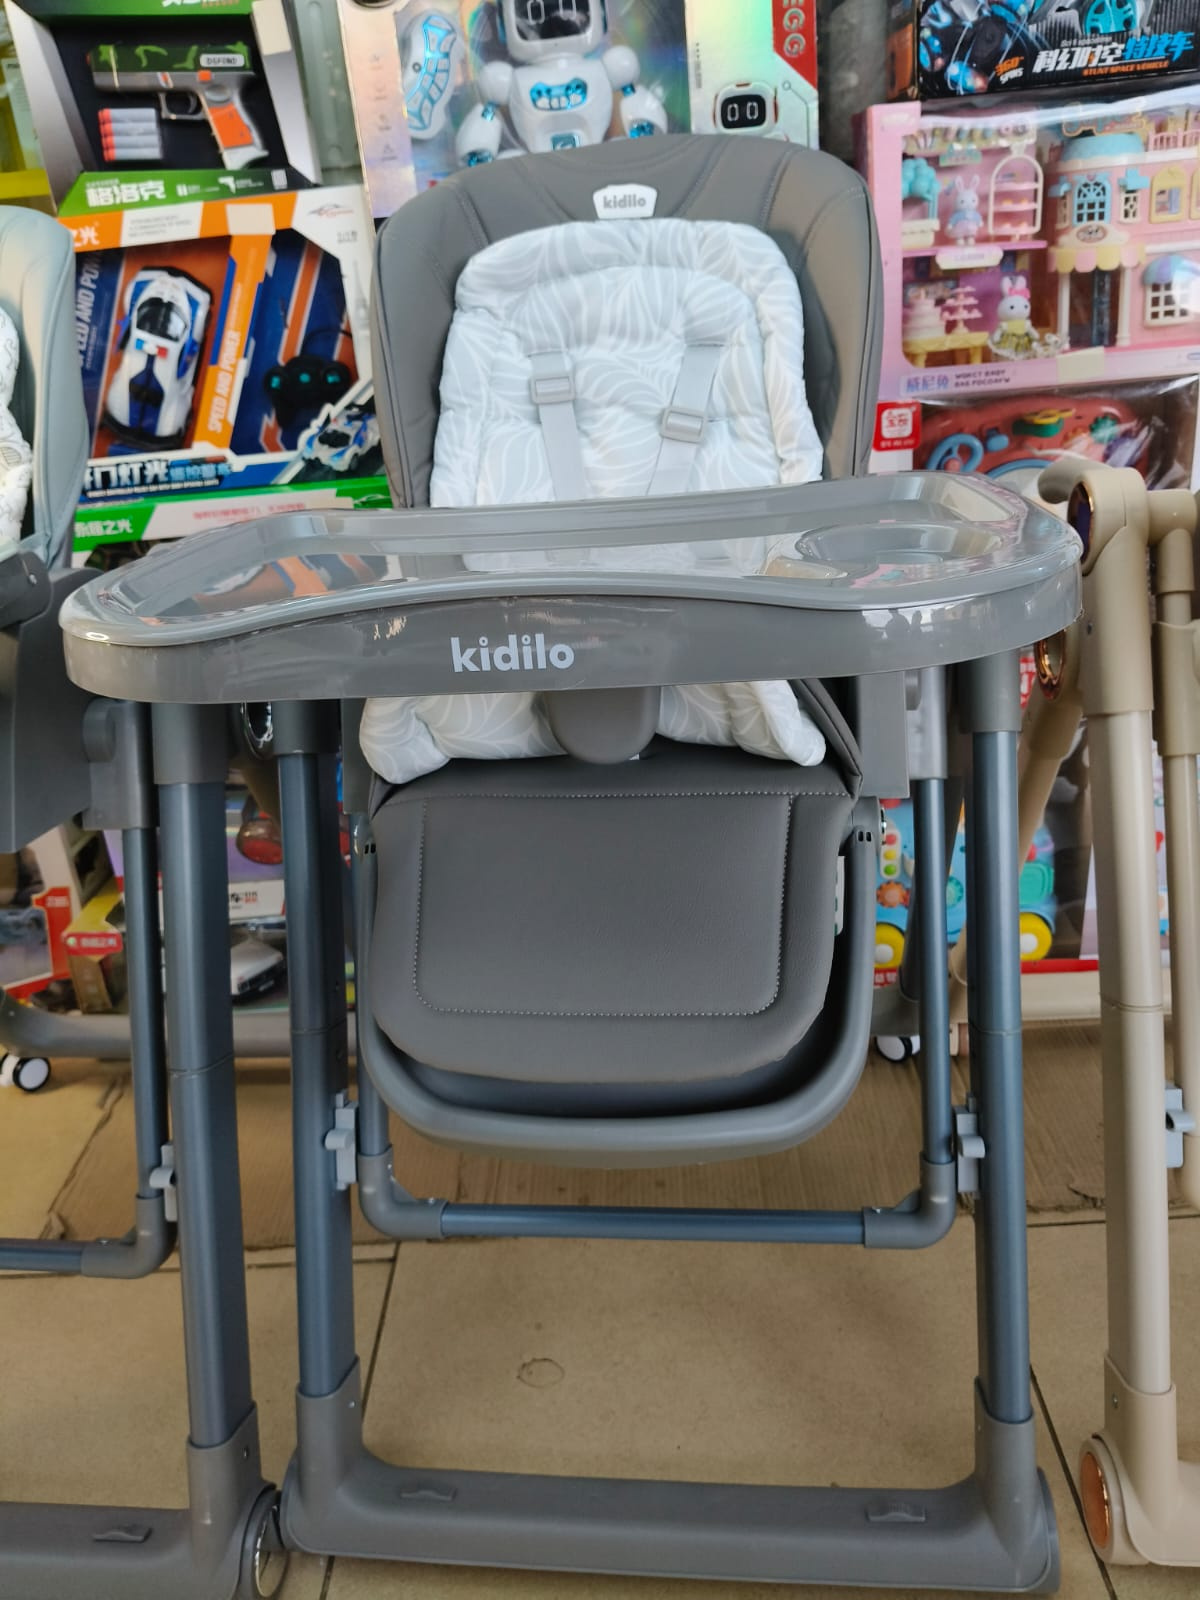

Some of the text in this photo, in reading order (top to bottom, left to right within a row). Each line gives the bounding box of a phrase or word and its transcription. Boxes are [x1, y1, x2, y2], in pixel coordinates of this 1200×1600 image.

[603, 194, 647, 209] kidilo
[76, 288, 96, 322] AND
[207, 329, 241, 433] SPEED AND POWER
[450, 632, 576, 673] kidilo
